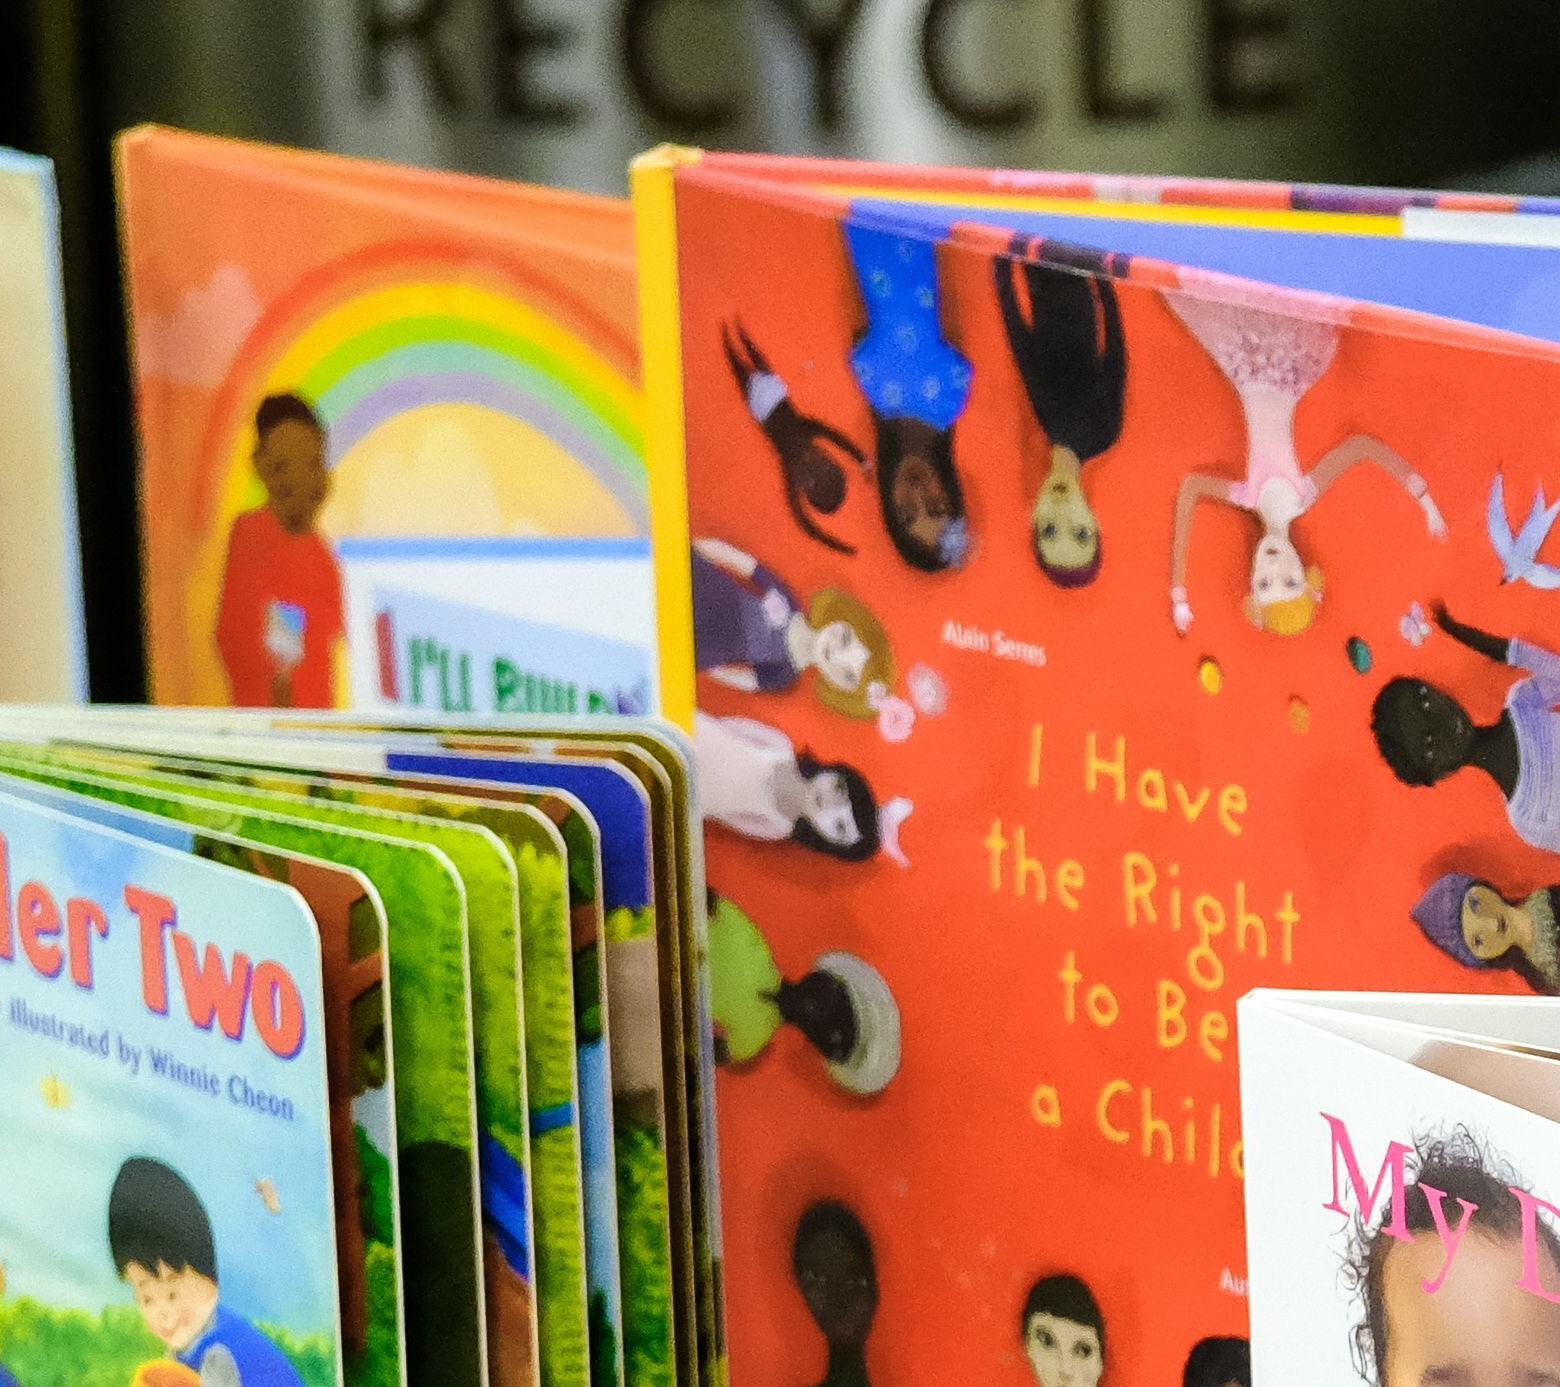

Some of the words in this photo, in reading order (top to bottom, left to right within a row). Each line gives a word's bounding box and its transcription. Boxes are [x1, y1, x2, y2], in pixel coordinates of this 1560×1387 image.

[359, 0, 1306, 128] RECYCLE
[943, 620, 990, 650] Alain
[1026, 723, 1044, 789] I
[1085, 730, 1249, 837] Have
[984, 816, 1086, 912] the
[1121, 850, 1303, 991] Right
[122, 883, 306, 1061] Two
[1057, 950, 1120, 1027] to
[1155, 978, 1231, 1062] Be
[117, 1033, 145, 1075] by
[148, 1048, 223, 1100] Winnie
[227, 1074, 298, 1121] Cheon
[1030, 1084, 1064, 1129] a
[1318, 1110, 1480, 1296] My
